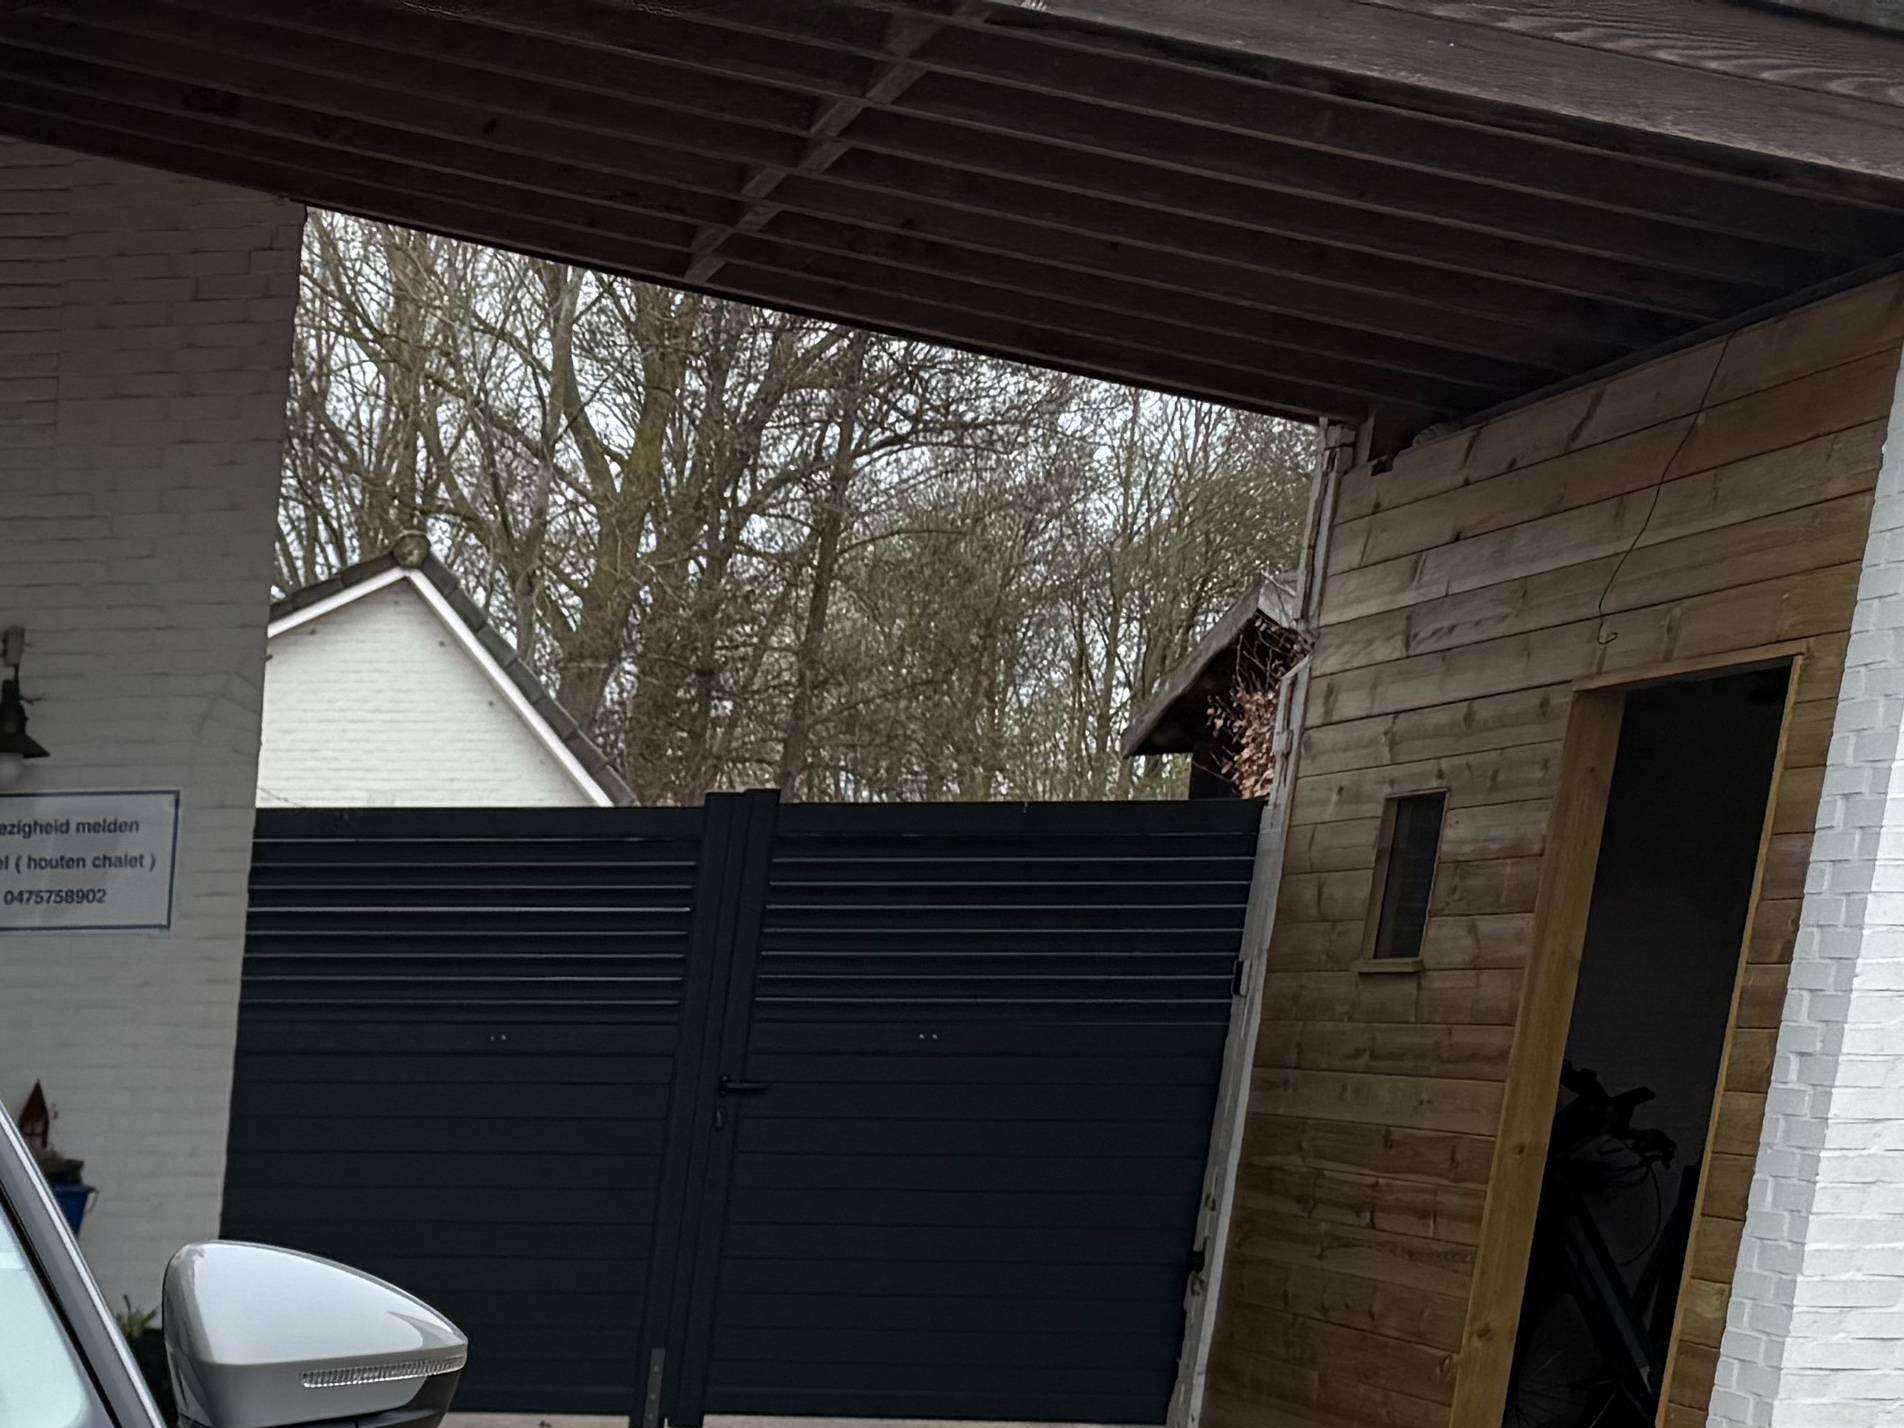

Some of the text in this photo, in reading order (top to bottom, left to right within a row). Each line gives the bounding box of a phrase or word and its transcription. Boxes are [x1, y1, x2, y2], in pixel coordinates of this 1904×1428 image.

[76, 818, 140, 834] melden
[27, 854, 86, 870] houten
[92, 852, 144, 869] chalet
